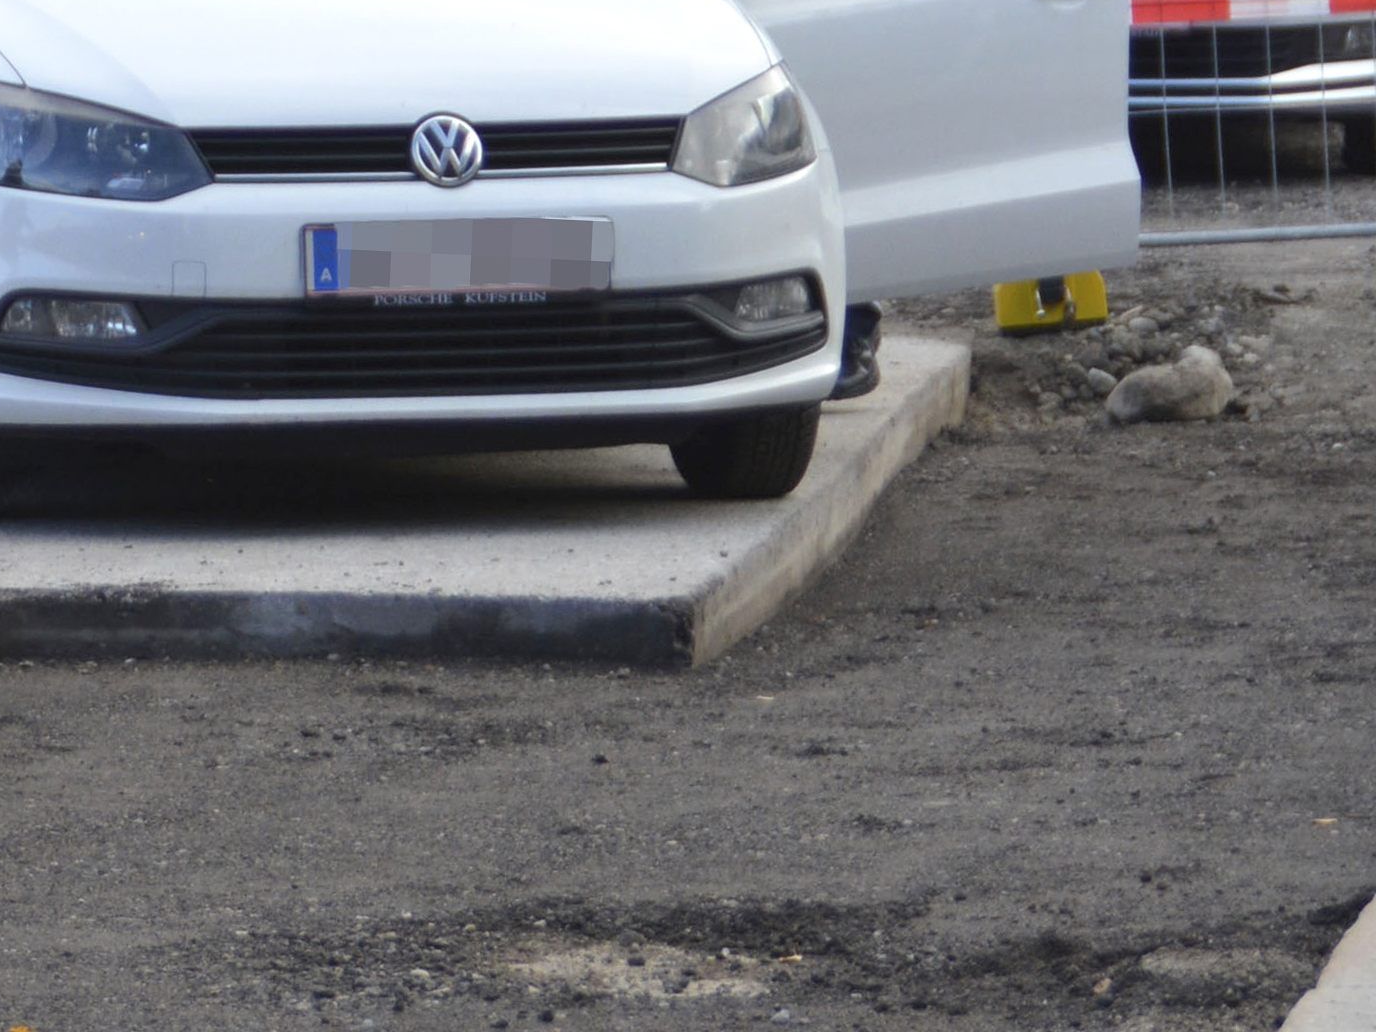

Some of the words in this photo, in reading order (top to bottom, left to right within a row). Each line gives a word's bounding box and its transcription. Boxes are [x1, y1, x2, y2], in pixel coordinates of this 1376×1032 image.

[319, 267, 334, 282] A
[374, 292, 453, 306] PORSCHE
[465, 290, 547, 305] KUFSTEIN
